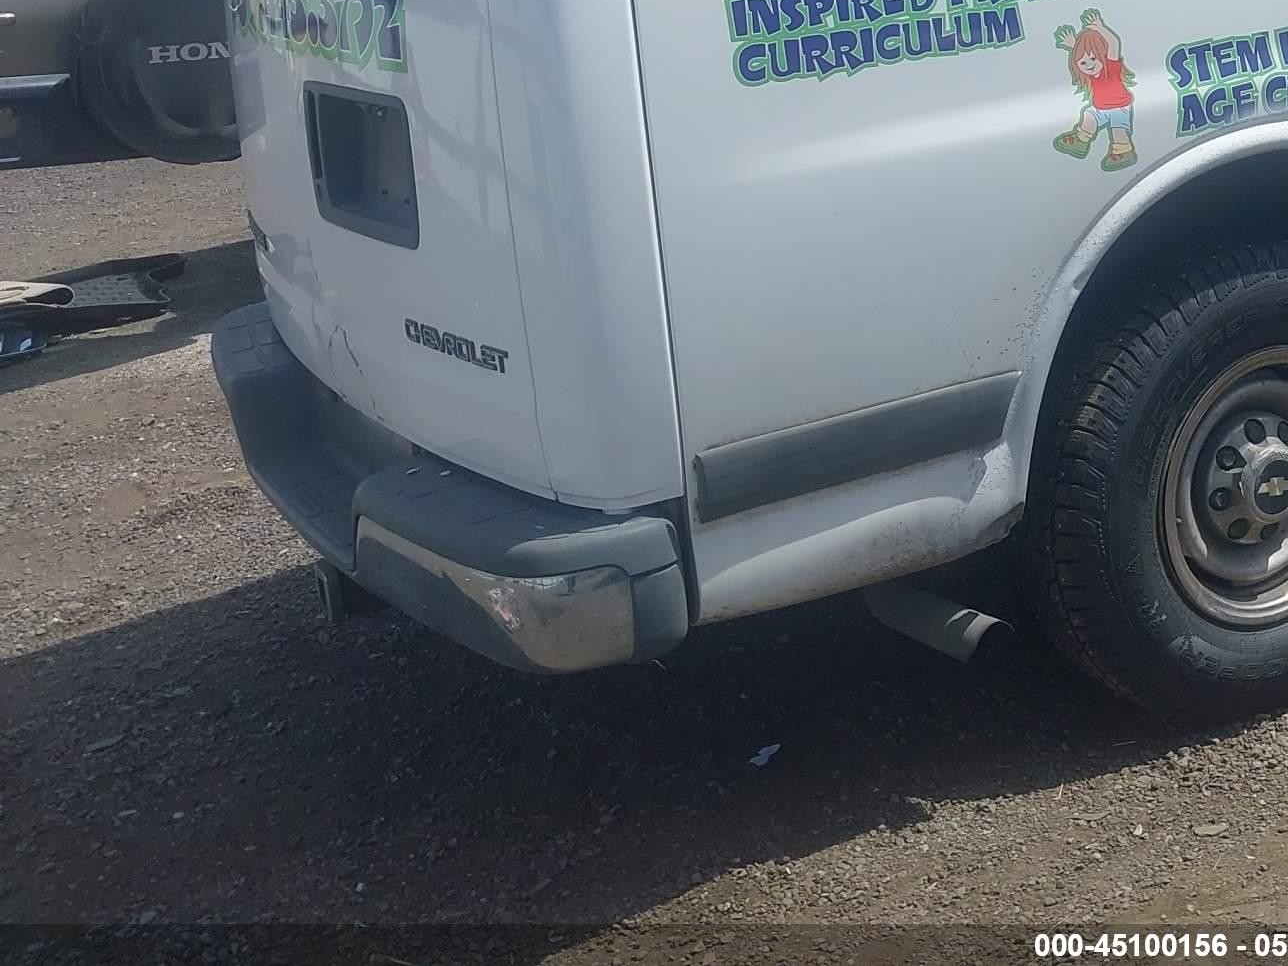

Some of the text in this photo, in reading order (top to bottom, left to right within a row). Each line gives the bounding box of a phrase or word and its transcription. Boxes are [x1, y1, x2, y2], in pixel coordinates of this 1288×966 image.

[737, 6, 1022, 84] CURRICULUM
[1169, 34, 1272, 88] STEM
[1179, 83, 1259, 133] AGE
[404, 318, 509, 374] CHEVROLET
